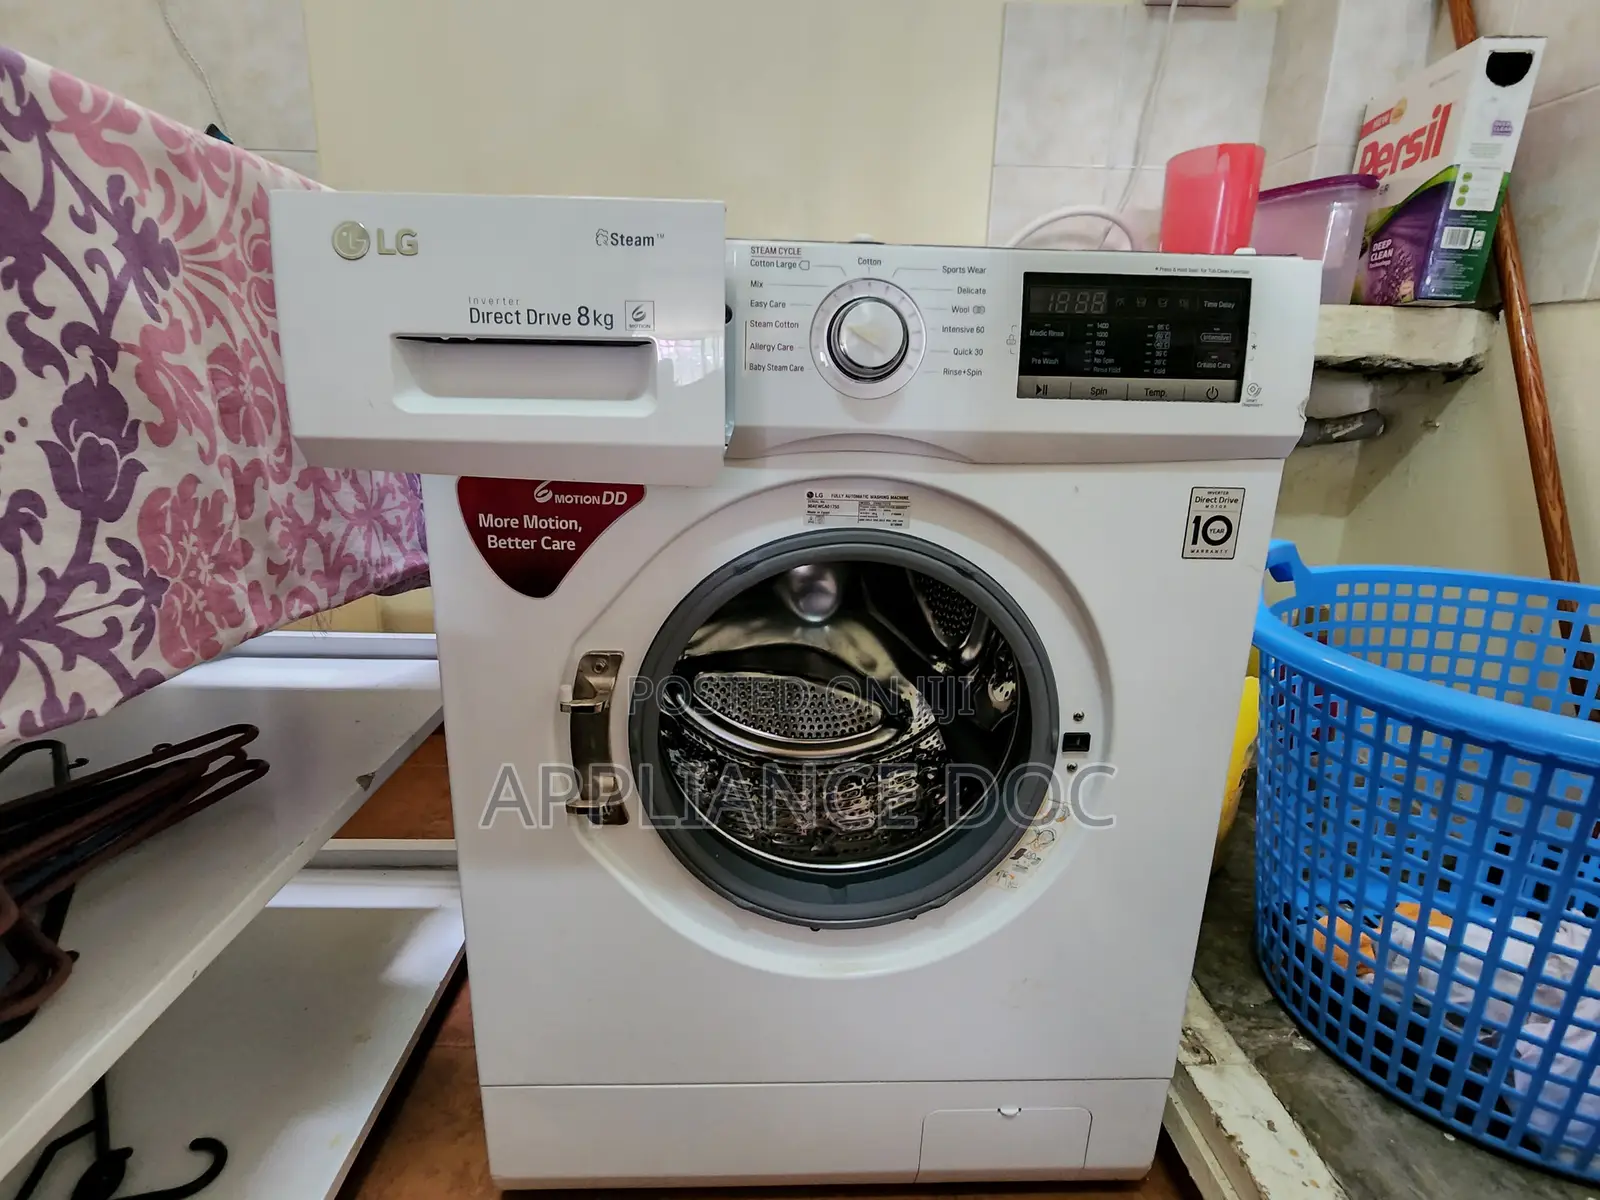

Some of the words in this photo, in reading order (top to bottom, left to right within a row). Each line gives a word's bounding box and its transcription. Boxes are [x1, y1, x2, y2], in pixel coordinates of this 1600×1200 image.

[1359, 103, 1452, 180] Persil
[377, 228, 418, 256] LG
[1372, 239, 1392, 251] DEEP
[750, 247, 776, 255] STEAM
[777, 248, 802, 256] CYCLE
[1370, 248, 1394, 261] CLEAN
[750, 260, 774, 268] Cotton
[775, 260, 797, 270] Large
[857, 257, 882, 266] Cotton
[942, 266, 966, 275] Sports
[967, 266, 986, 274] Wear
[750, 280, 763, 288] Mix
[957, 287, 986, 295] Delicate
[468, 296, 520, 306] Inverter
[750, 300, 768, 309] Easy
[769, 300, 786, 308] Care
[1218, 301, 1235, 309] Delay
[469, 307, 521, 325] Direct
[526, 308, 572, 326] Drive
[749, 320, 773, 328] Steam
[774, 321, 799, 329] Cotton
[942, 326, 975, 334] Intensive
[750, 343, 777, 353] Allergy
[777, 343, 794, 351] Care
[953, 348, 973, 356] Quick
[974, 348, 984, 356] 30
[749, 363, 766, 373] Baby
[766, 364, 787, 372] Steam
[788, 364, 804, 372] Care
[943, 368, 983, 377] Rinse+Spin
[1090, 387, 1108, 398] Spin
[1144, 388, 1168, 399] Temp.
[478, 513, 519, 529] More
[523, 515, 582, 533] Motion,
[1191, 515, 1233, 546] 10
[487, 535, 537, 549] Better
[541, 536, 576, 551] Care
